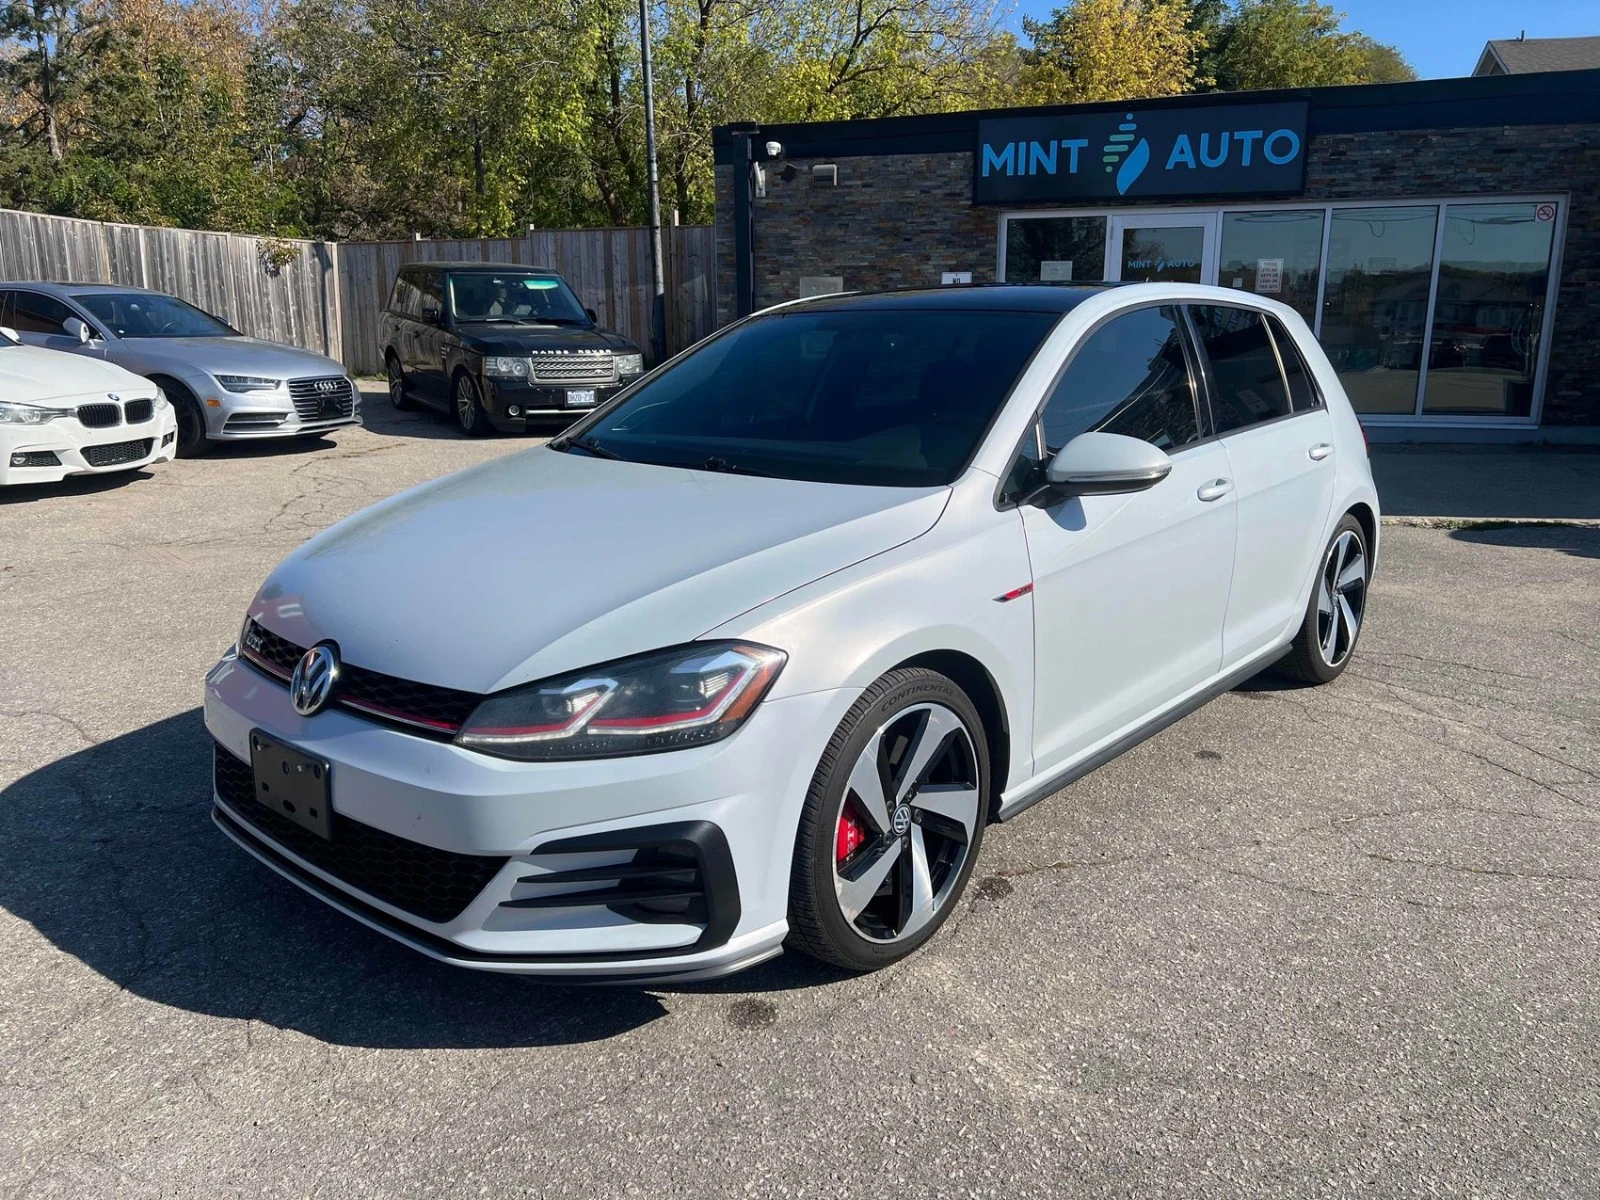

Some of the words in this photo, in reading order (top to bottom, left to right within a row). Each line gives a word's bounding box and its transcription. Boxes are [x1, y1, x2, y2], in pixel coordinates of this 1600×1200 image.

[982, 138, 1088, 177] MINT
[1165, 129, 1300, 170] AUTO
[1127, 260, 1152, 269] MINT
[1167, 259, 1196, 268] AUTO
[881, 684, 954, 712] CONTINENTAL
